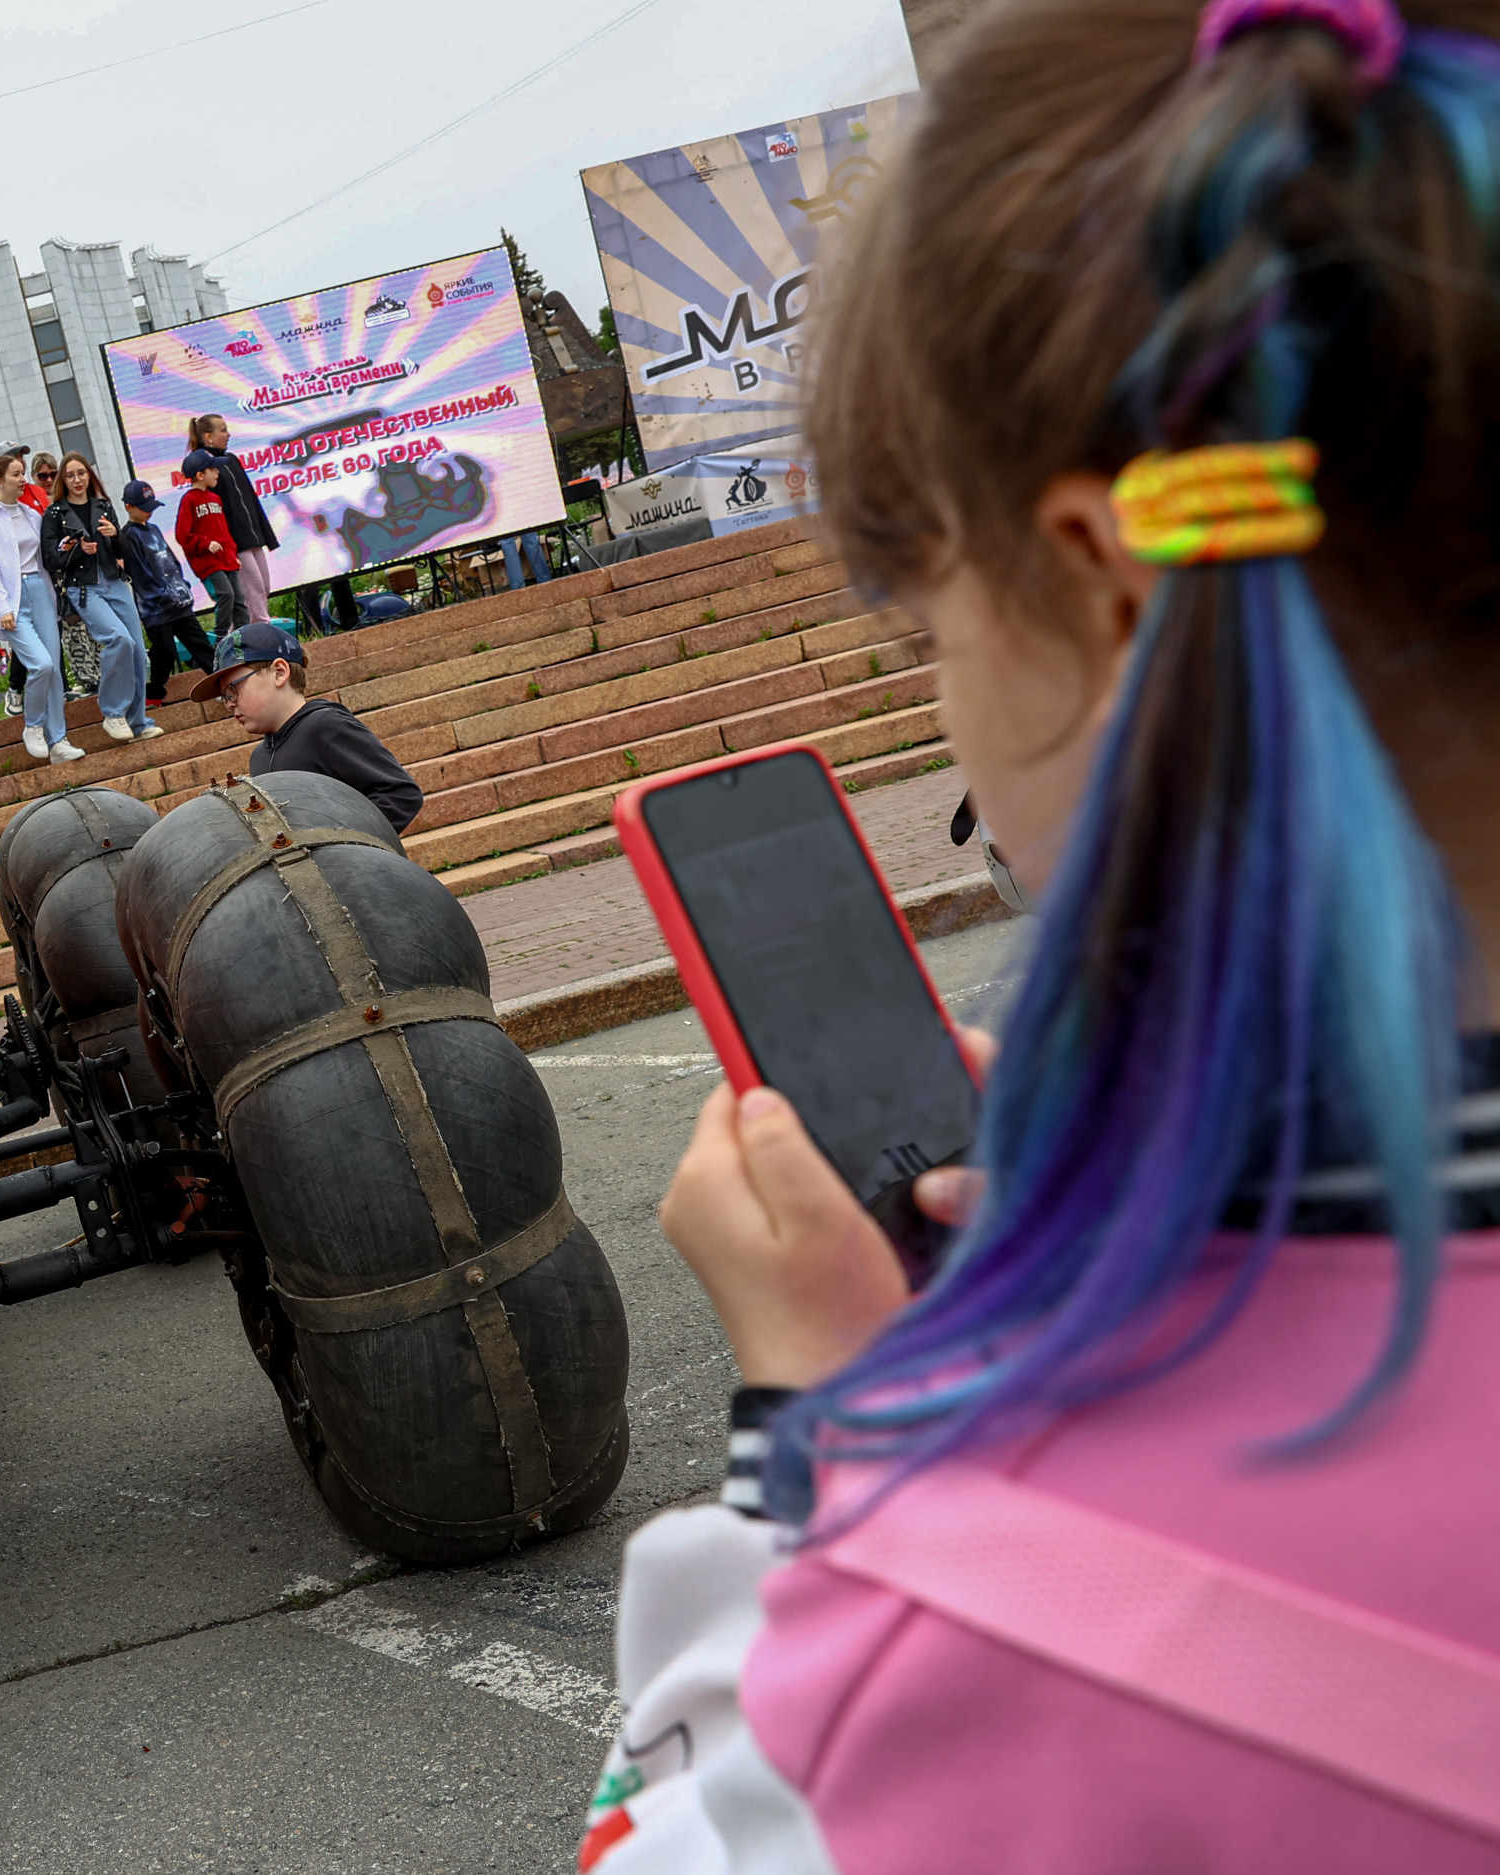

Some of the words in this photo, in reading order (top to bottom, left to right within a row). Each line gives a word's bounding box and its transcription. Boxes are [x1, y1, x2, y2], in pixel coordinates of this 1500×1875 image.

[444, 277, 475, 291] ЯРКИЕ
[446, 282, 494, 300] СОБЫТИЯ
[282, 355, 368, 385] Ретро-фестиваль
[309, 384, 517, 453] ОТЕЧЕСТВЕННЫЙ
[255, 463, 337, 496] ПОСЛЕ
[343, 454, 372, 475] 60
[377, 436, 443, 467] ГОДА
